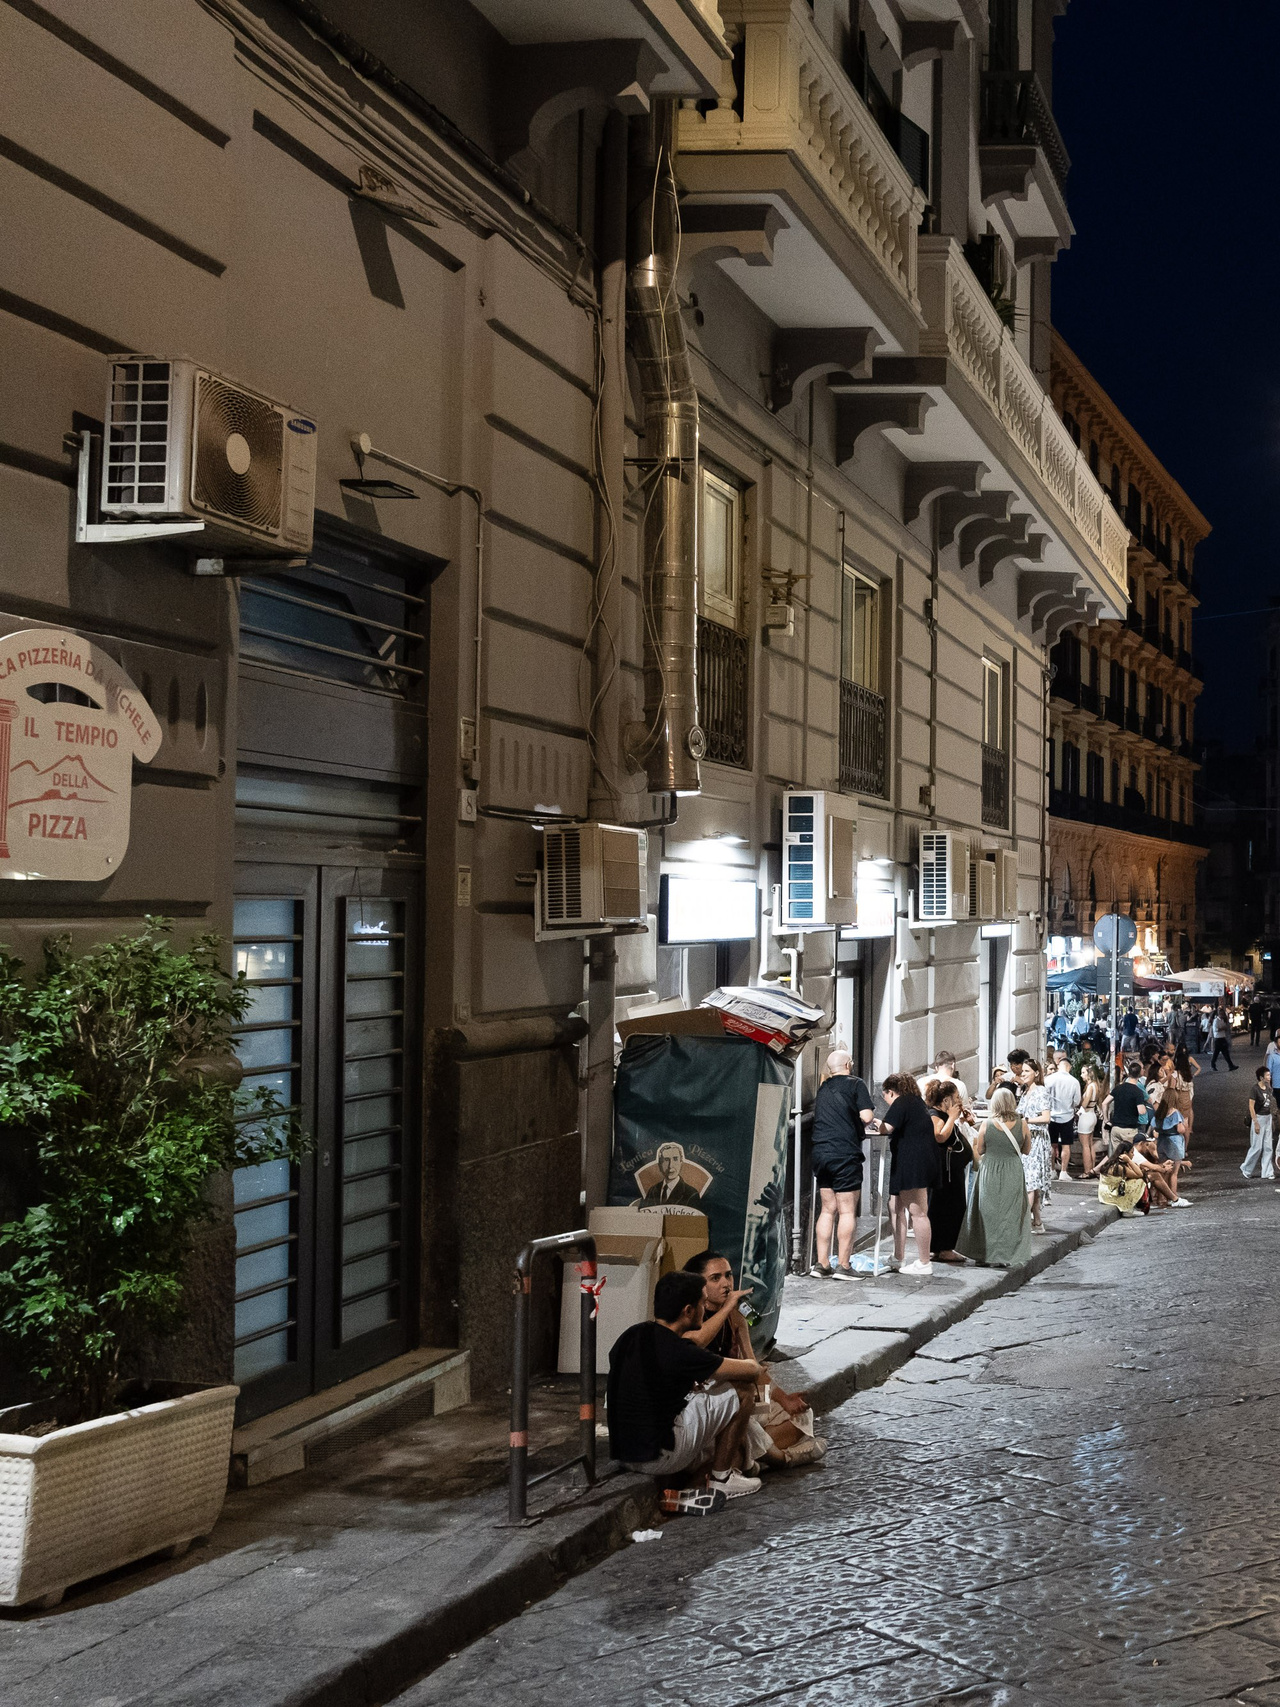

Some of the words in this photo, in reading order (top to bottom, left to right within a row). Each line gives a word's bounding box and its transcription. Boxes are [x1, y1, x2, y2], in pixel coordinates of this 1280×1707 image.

[18, 648, 82, 671] PIZZERIA
[85, 660, 104, 685] DA
[105, 677, 152, 746] MICHELE
[24, 716, 39, 738] IL
[54, 720, 119, 748] TEMPIO
[52, 772, 89, 789] DELLA
[465, 796, 473, 815] 8
[28, 813, 88, 840] PIZZA
[688, 1143, 726, 1173] Pizzeria
